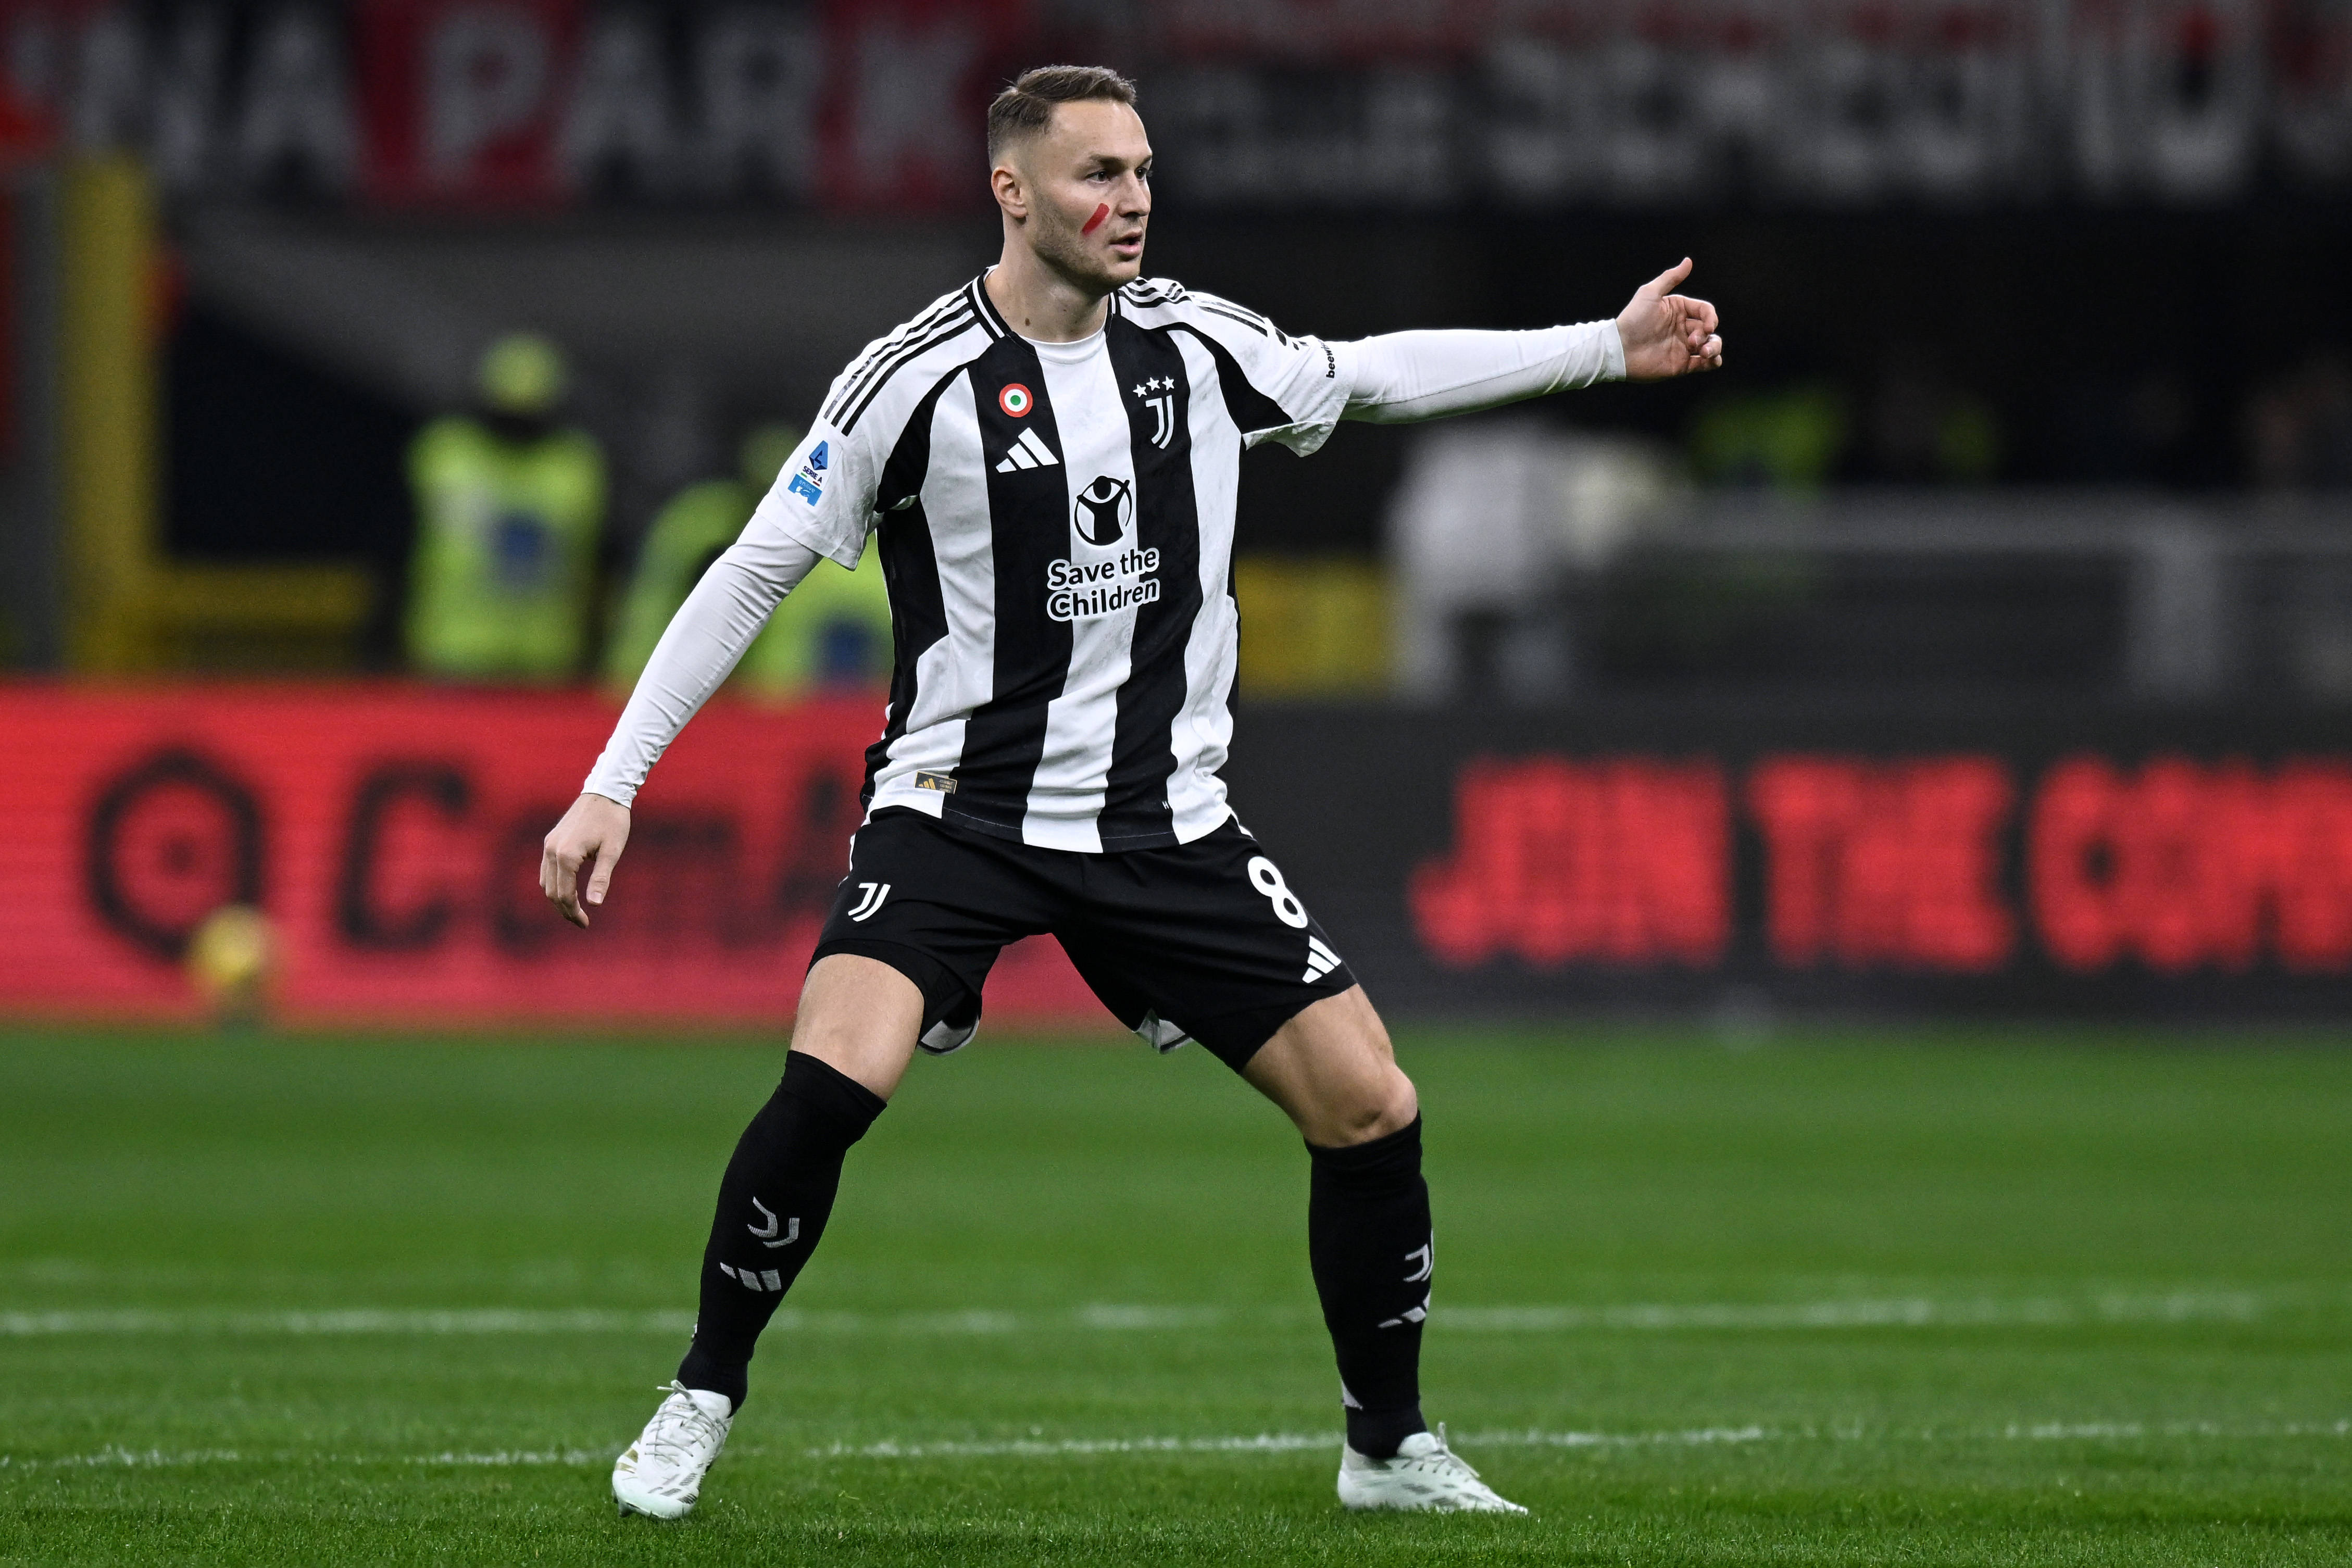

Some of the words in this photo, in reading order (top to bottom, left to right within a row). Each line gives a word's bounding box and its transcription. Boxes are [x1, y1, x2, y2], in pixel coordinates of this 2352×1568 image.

[421, 10, 982, 190] PARK
[803, 466, 818, 480] SERIE
[1050, 562, 1115, 586] Save
[1120, 548, 1157, 575] the
[1050, 581, 1157, 618] Children
[1419, 766, 1721, 956] JOIN
[1755, 766, 2000, 958] THE
[1248, 856, 1308, 929] 8
